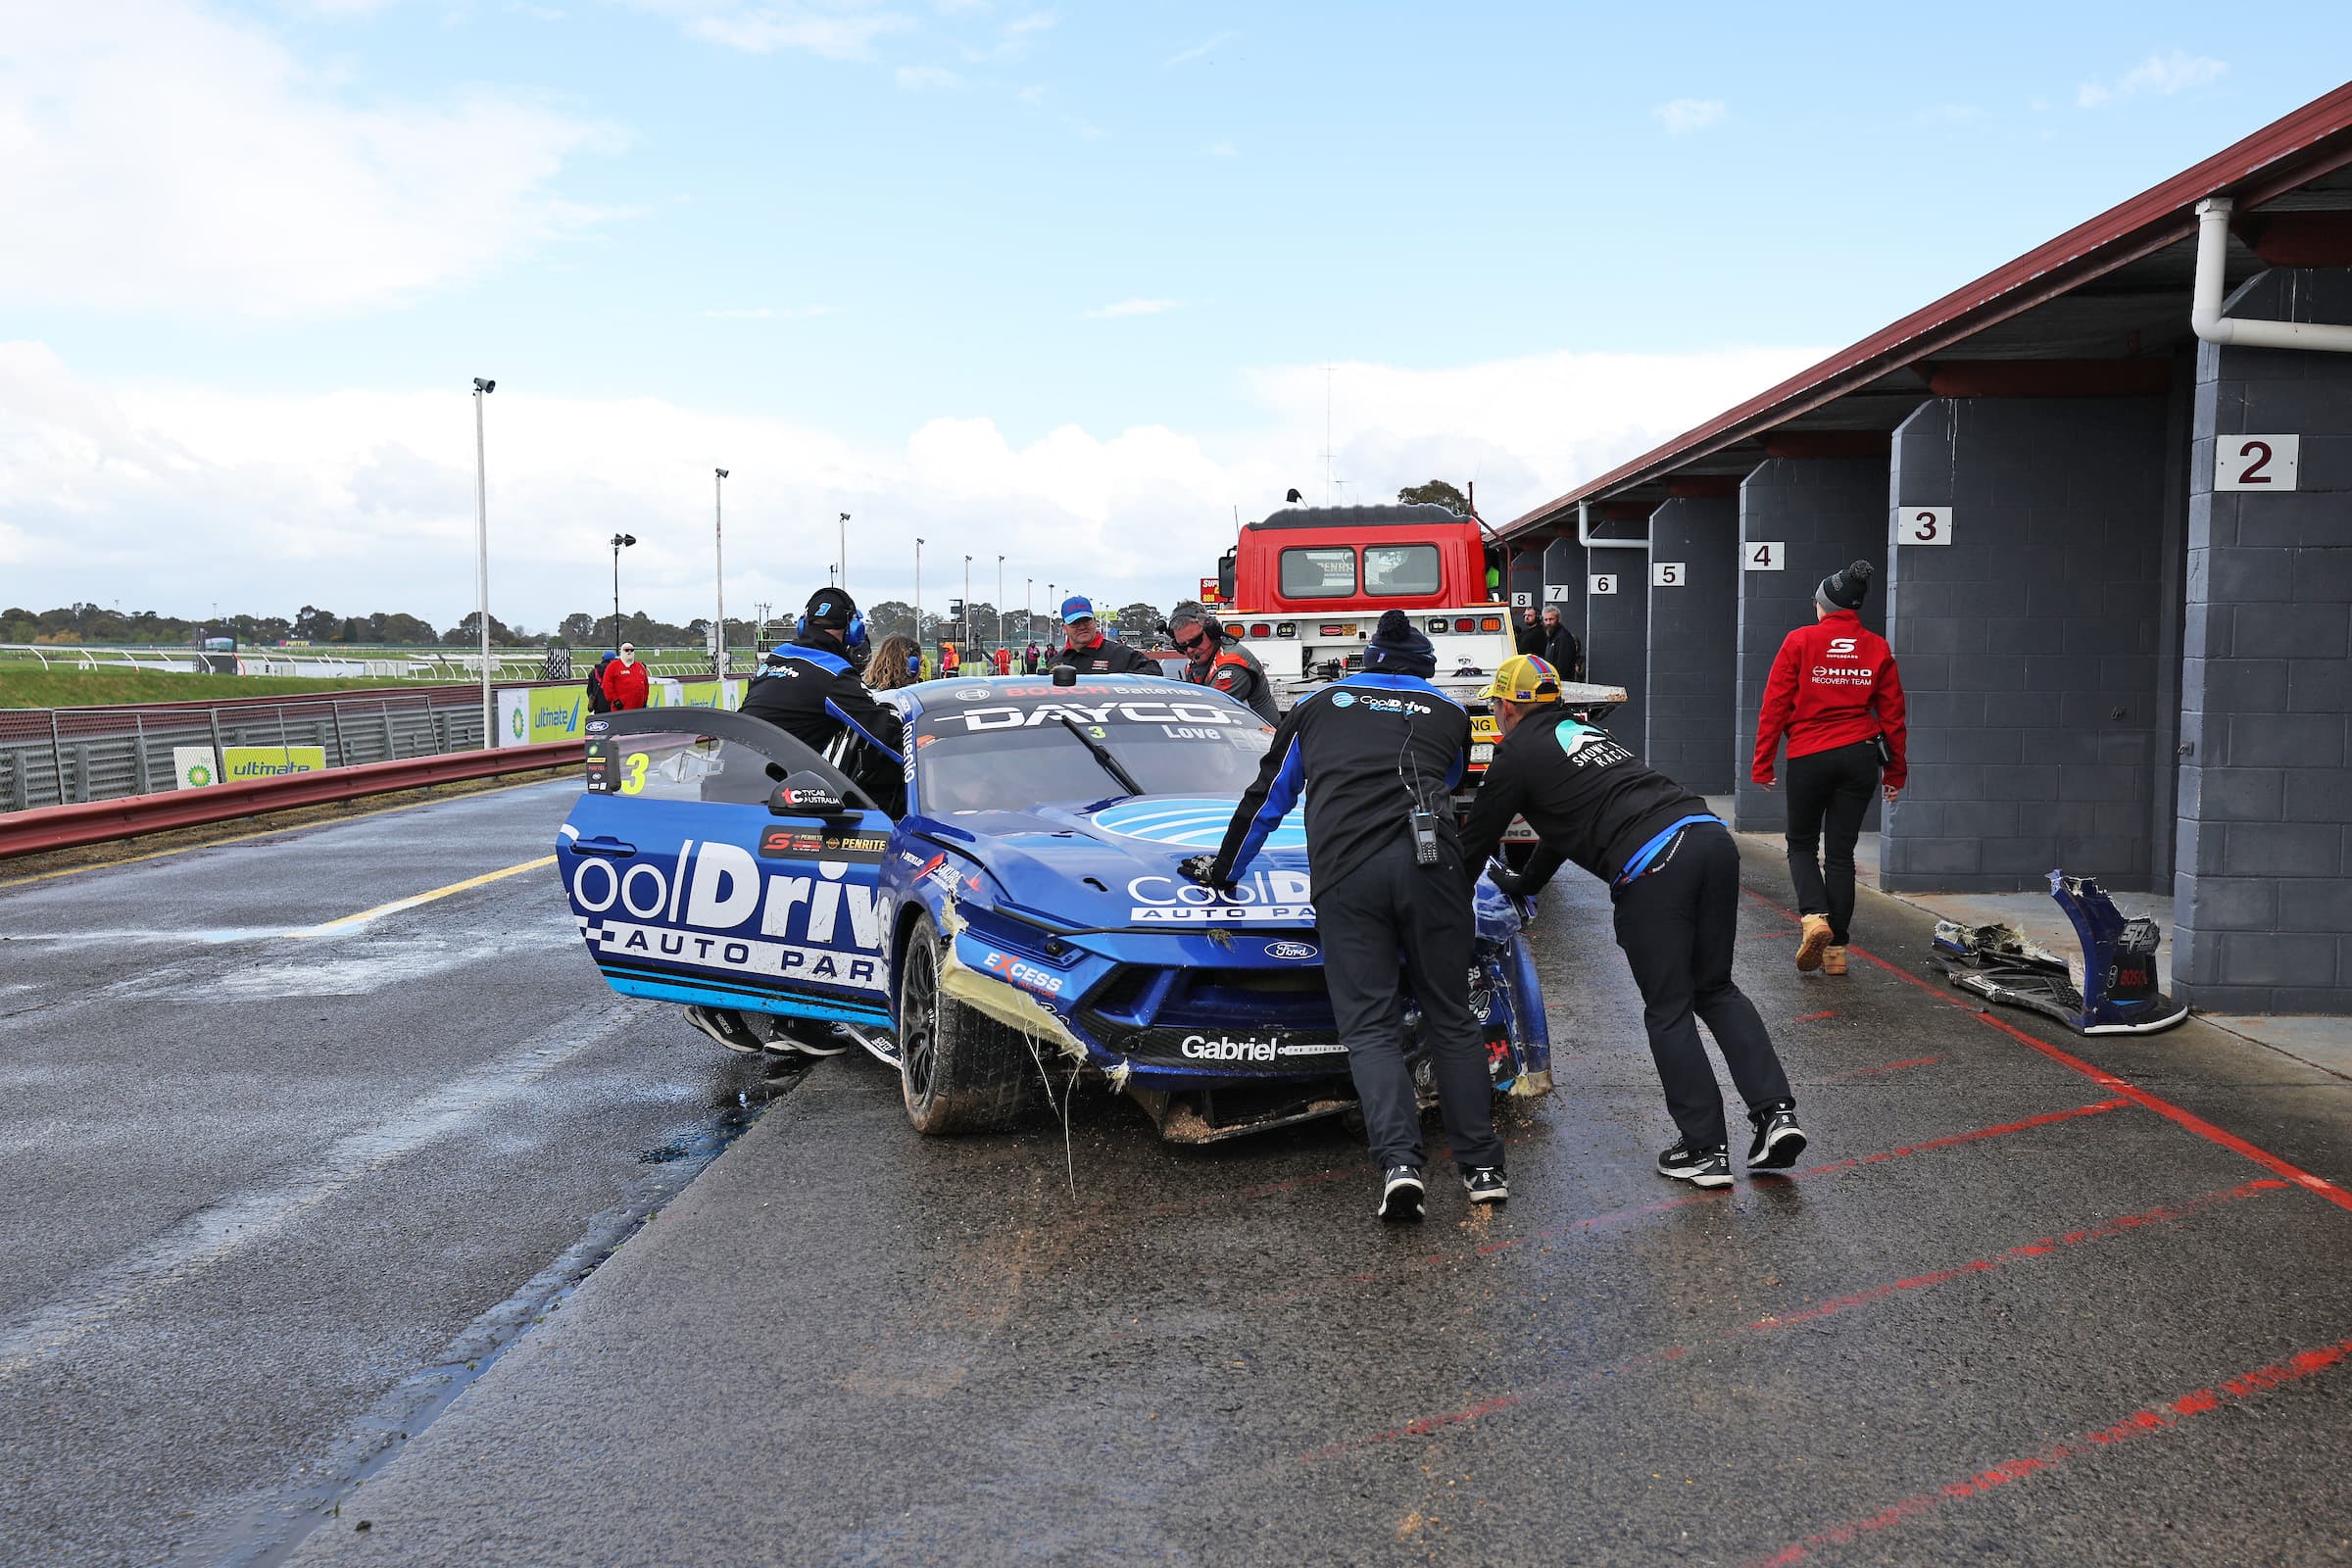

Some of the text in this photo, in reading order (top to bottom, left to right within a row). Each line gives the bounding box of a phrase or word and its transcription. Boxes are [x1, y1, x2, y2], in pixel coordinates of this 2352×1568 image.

[2238, 440, 2274, 484] 2
[1914, 512, 1936, 541] 3
[1753, 545, 1772, 566] 4
[1662, 565, 1677, 583] 5
[1597, 576, 1609, 592] 6
[1517, 594, 1526, 605] 8
[1551, 587, 1562, 600] 7
[1811, 676, 1850, 685] RECOVERY
[1828, 667, 1873, 677] HINO
[1004, 685, 1203, 698] BOSCH Batteries
[535, 706, 568, 728] ultimate
[963, 702, 1233, 731] DAYCO
[1088, 726, 1106, 739] 3
[1161, 724, 1221, 740] Love
[1572, 743, 1608, 767] SNOWY
[234, 761, 311, 775] ultimate
[620, 752, 650, 795] 3
[803, 796, 840, 805] AUSTRALIA
[842, 838, 886, 851] PENRITE
[572, 839, 891, 950] oolDriv
[1127, 870, 1311, 906] CoolD
[1143, 908, 1316, 918] AUTO PA
[624, 930, 875, 982] AUTO PAR
[1276, 944, 1308, 957] Ford
[983, 952, 1063, 992] EXCESS
[1181, 1035, 1278, 1061] Gabriel
